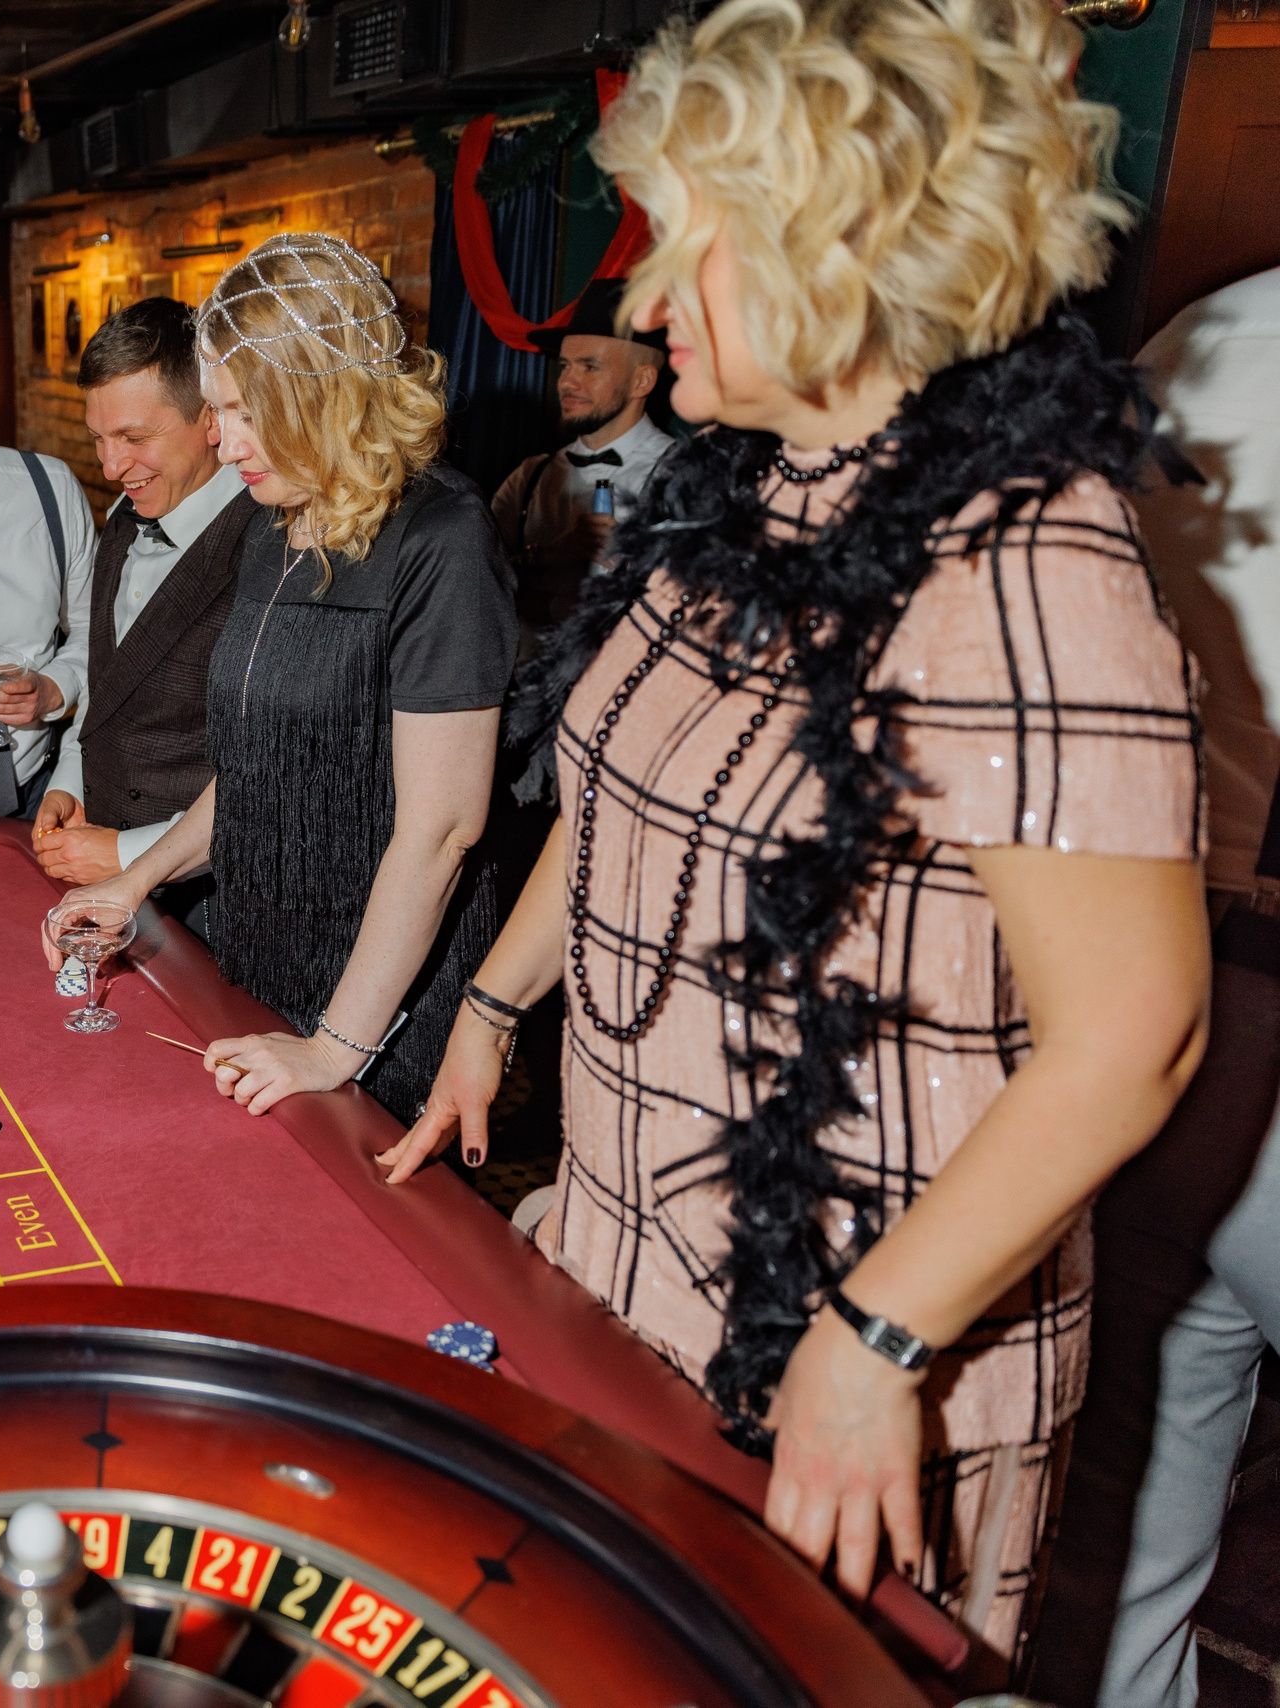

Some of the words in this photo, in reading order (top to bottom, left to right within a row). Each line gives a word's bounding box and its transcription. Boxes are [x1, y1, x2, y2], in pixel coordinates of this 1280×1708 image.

[6, 1194, 58, 1252] Even
[145, 1525, 174, 1578] 4
[200, 1537, 259, 1598] 21
[279, 1565, 323, 1621] 2
[331, 1592, 404, 1660] 25
[395, 1637, 471, 1699] 17
